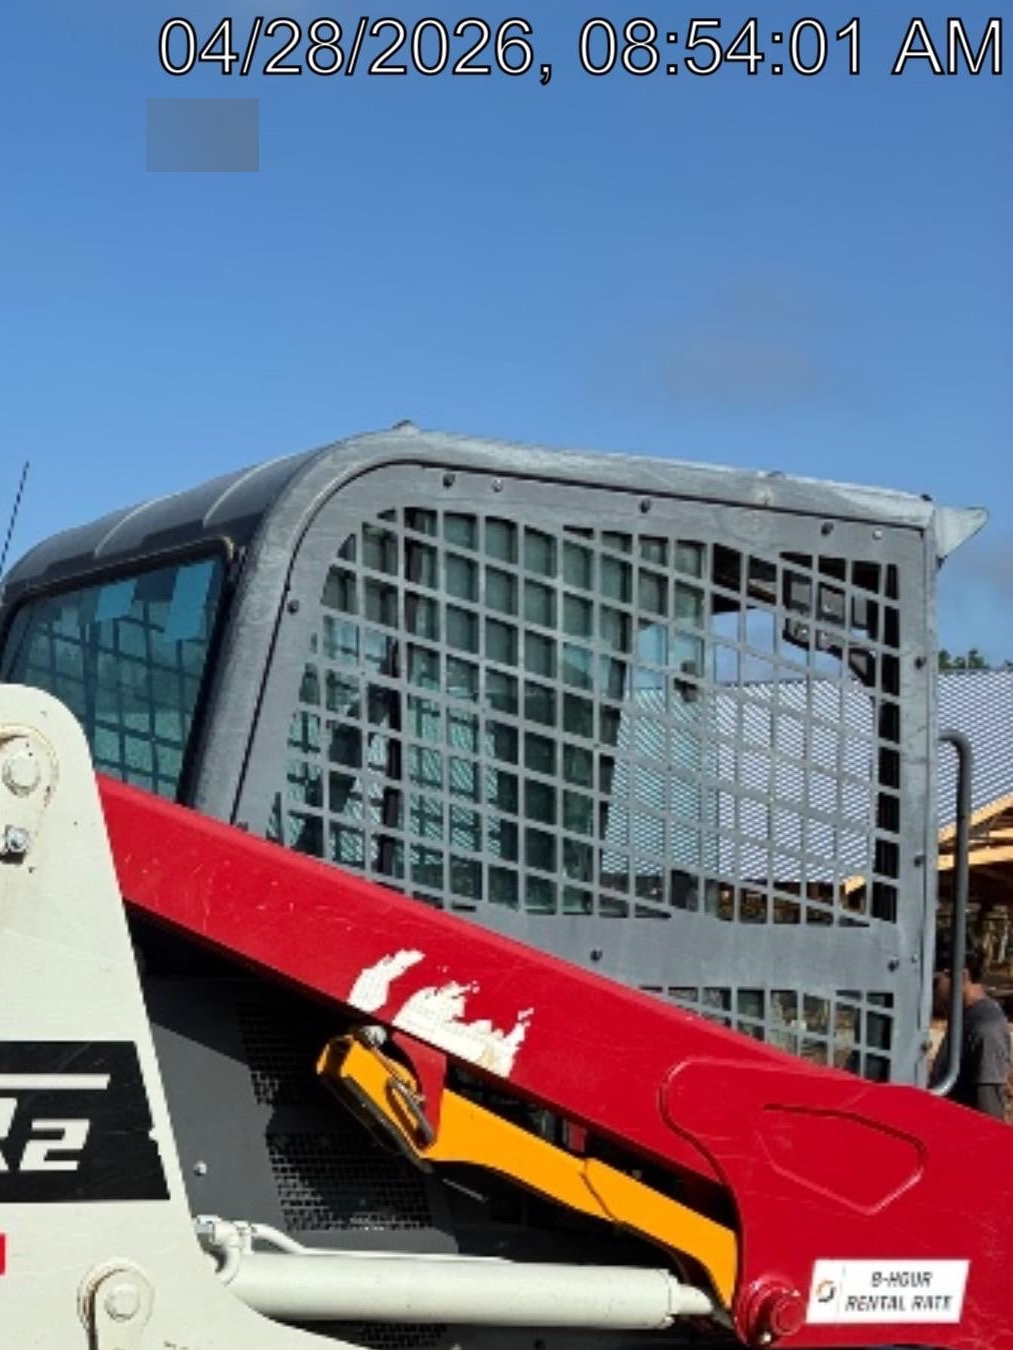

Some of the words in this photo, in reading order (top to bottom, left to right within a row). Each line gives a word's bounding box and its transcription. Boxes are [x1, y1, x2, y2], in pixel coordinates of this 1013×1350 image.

[871, 1271, 933, 1288] 8-HOUR
[845, 1295, 906, 1312] RENTAL
[911, 1295, 952, 1312] RATE
